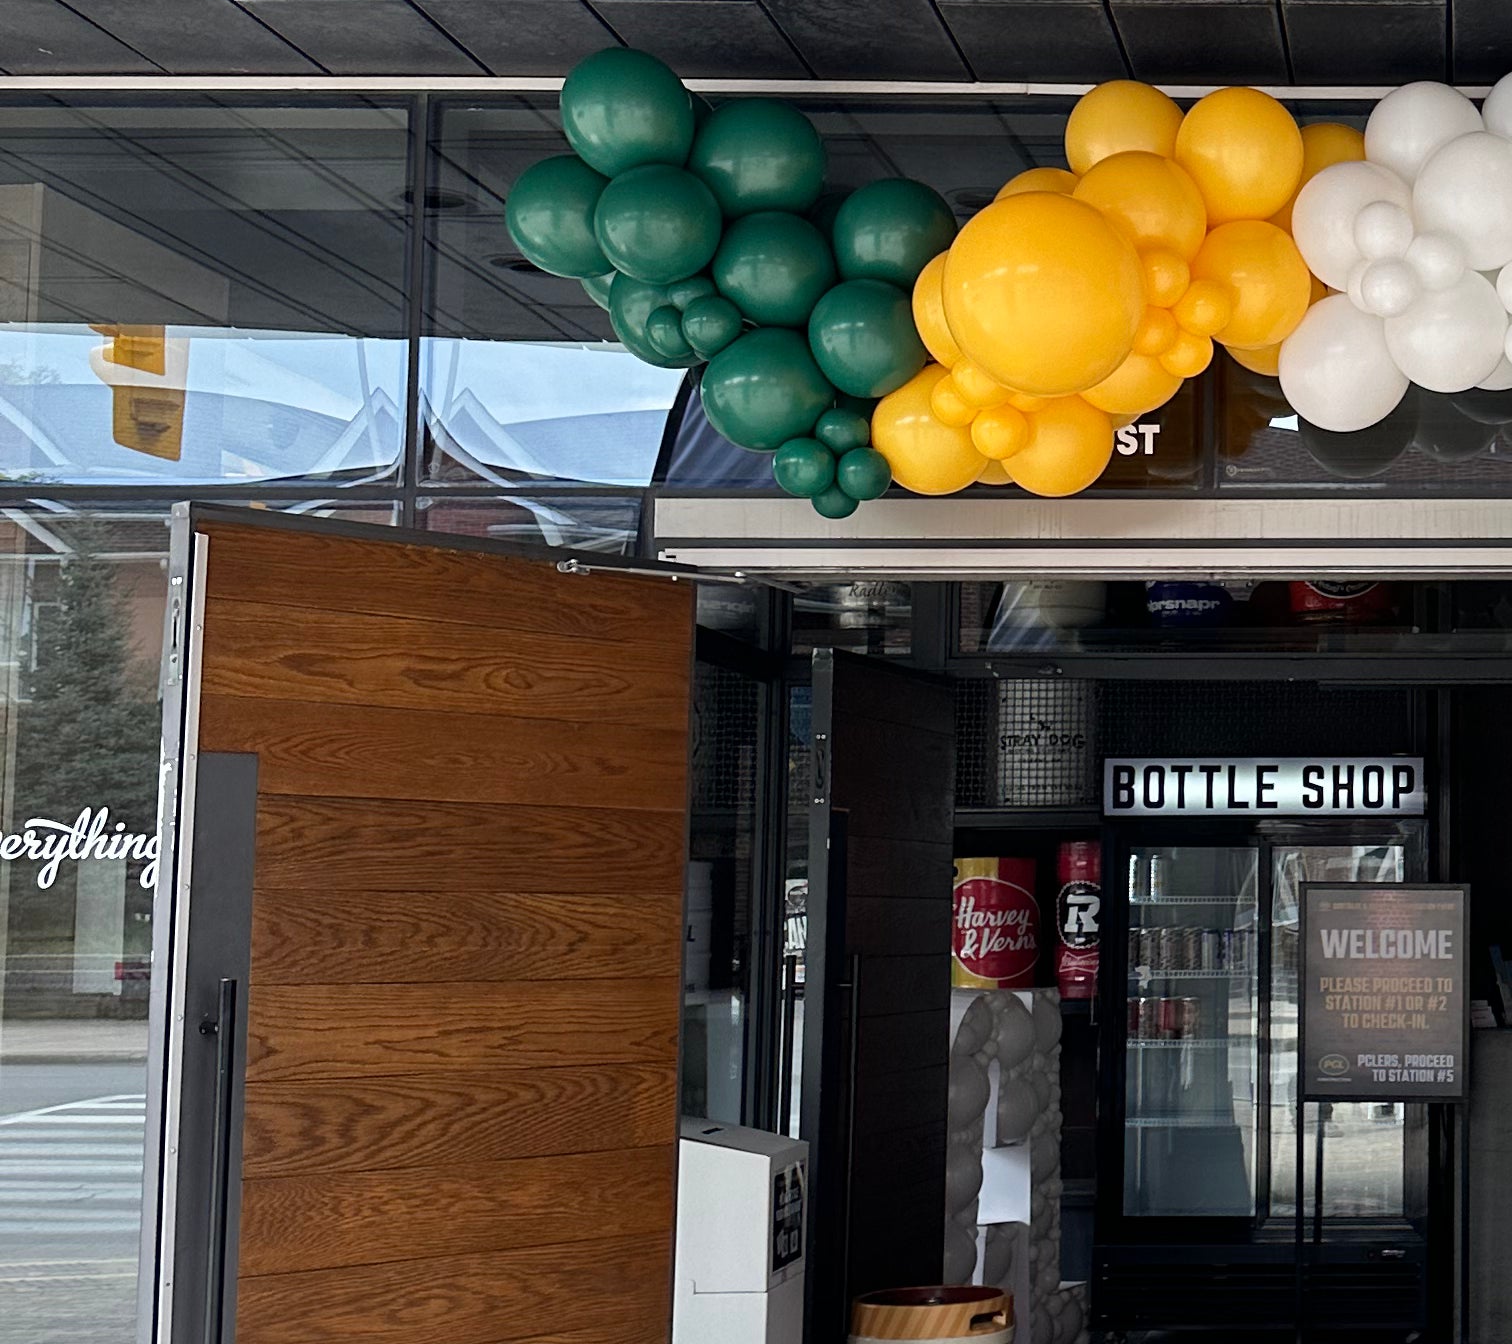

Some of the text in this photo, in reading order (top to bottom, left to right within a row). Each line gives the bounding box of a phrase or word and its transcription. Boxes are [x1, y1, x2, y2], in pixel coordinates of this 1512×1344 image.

[1049, 734, 1087, 749] DOG
[1112, 764, 1415, 809] BOTTLE SHOP
[0, 806, 161, 889] erything
[956, 896, 1034, 935] Harvey
[1319, 929, 1453, 959] WELCOME
[1319, 977, 1453, 993] PLEASE PROCEED TO
[1325, 995, 1447, 1011] STATION #1 OR #2
[1341, 1013, 1359, 1029] TO
[1405, 1054, 1454, 1068] PROCEED
[1372, 1069, 1454, 1083] TO STATION #5
